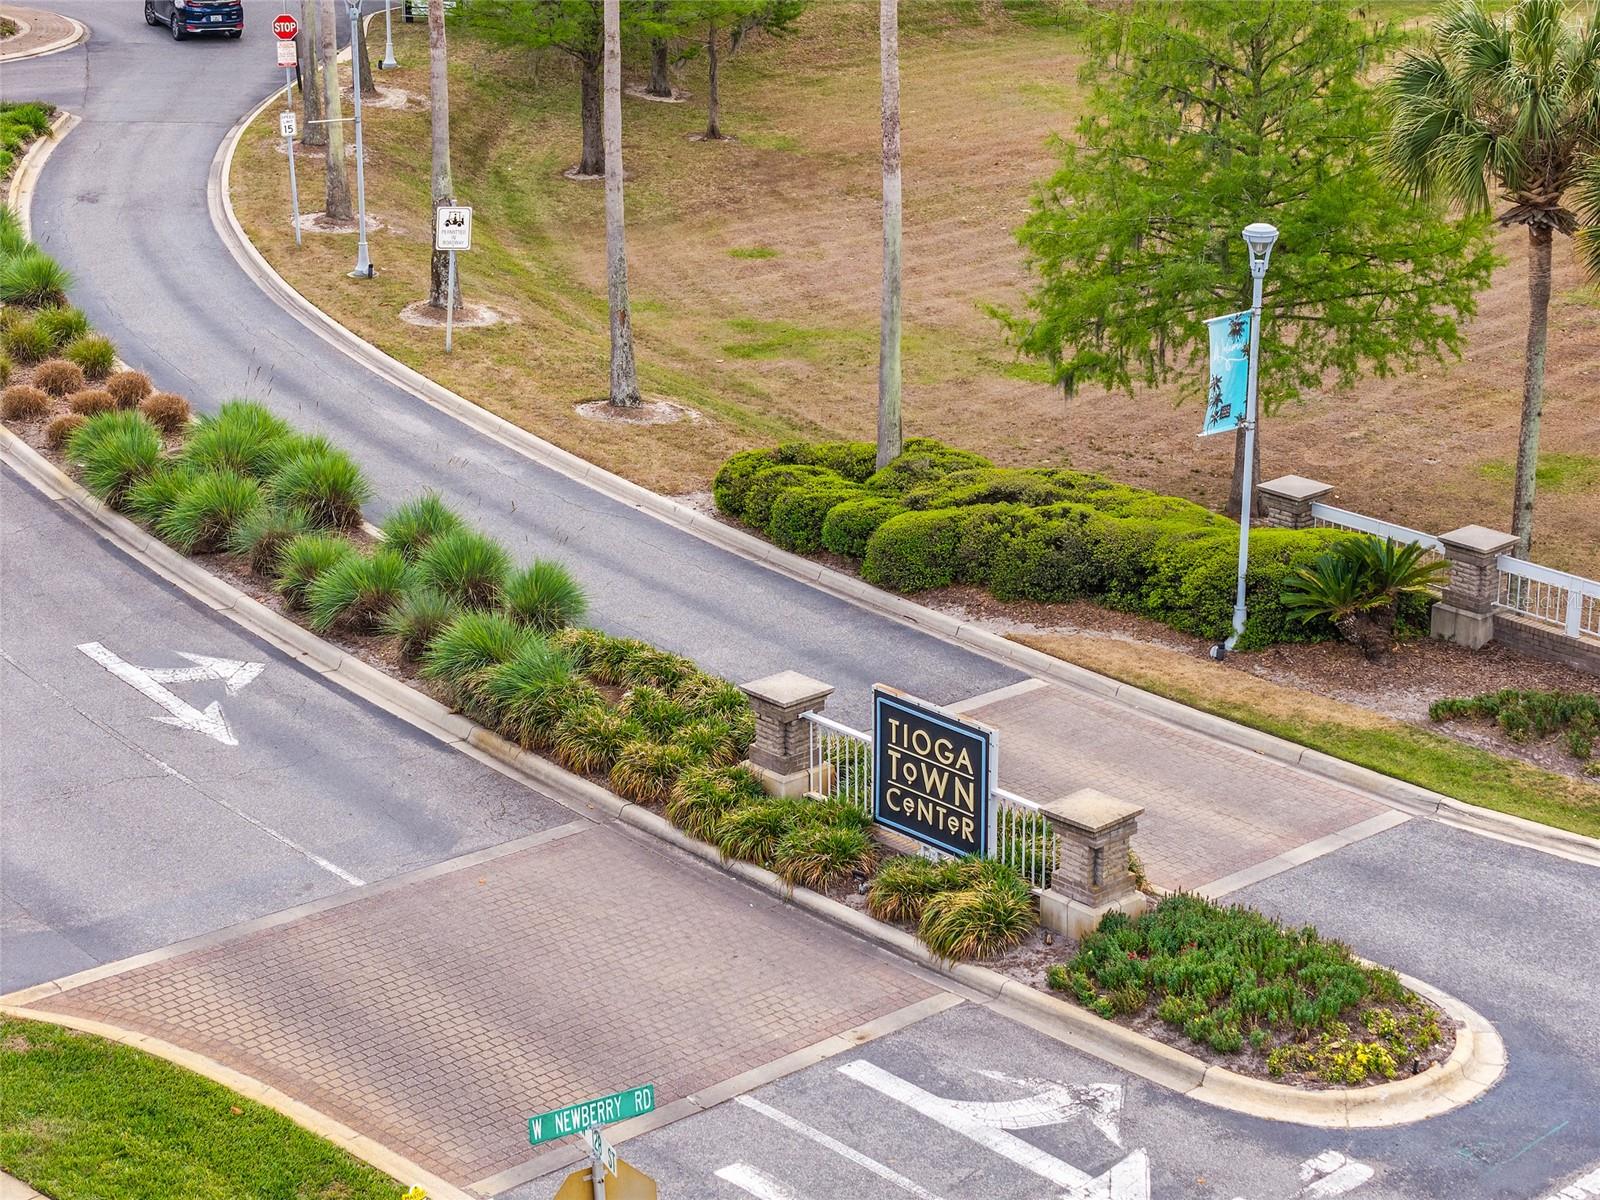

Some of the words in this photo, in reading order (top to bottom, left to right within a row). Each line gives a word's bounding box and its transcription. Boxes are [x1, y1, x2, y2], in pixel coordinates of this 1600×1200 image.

[274, 22, 296, 33] STOP
[284, 125, 294, 133] 15
[888, 718, 974, 775] TIOGA
[531, 1118, 542, 1141] W
[554, 1095, 622, 1134] NEWBERRY
[634, 1088, 651, 1112] RD
[607, 1147, 616, 1173] ST
